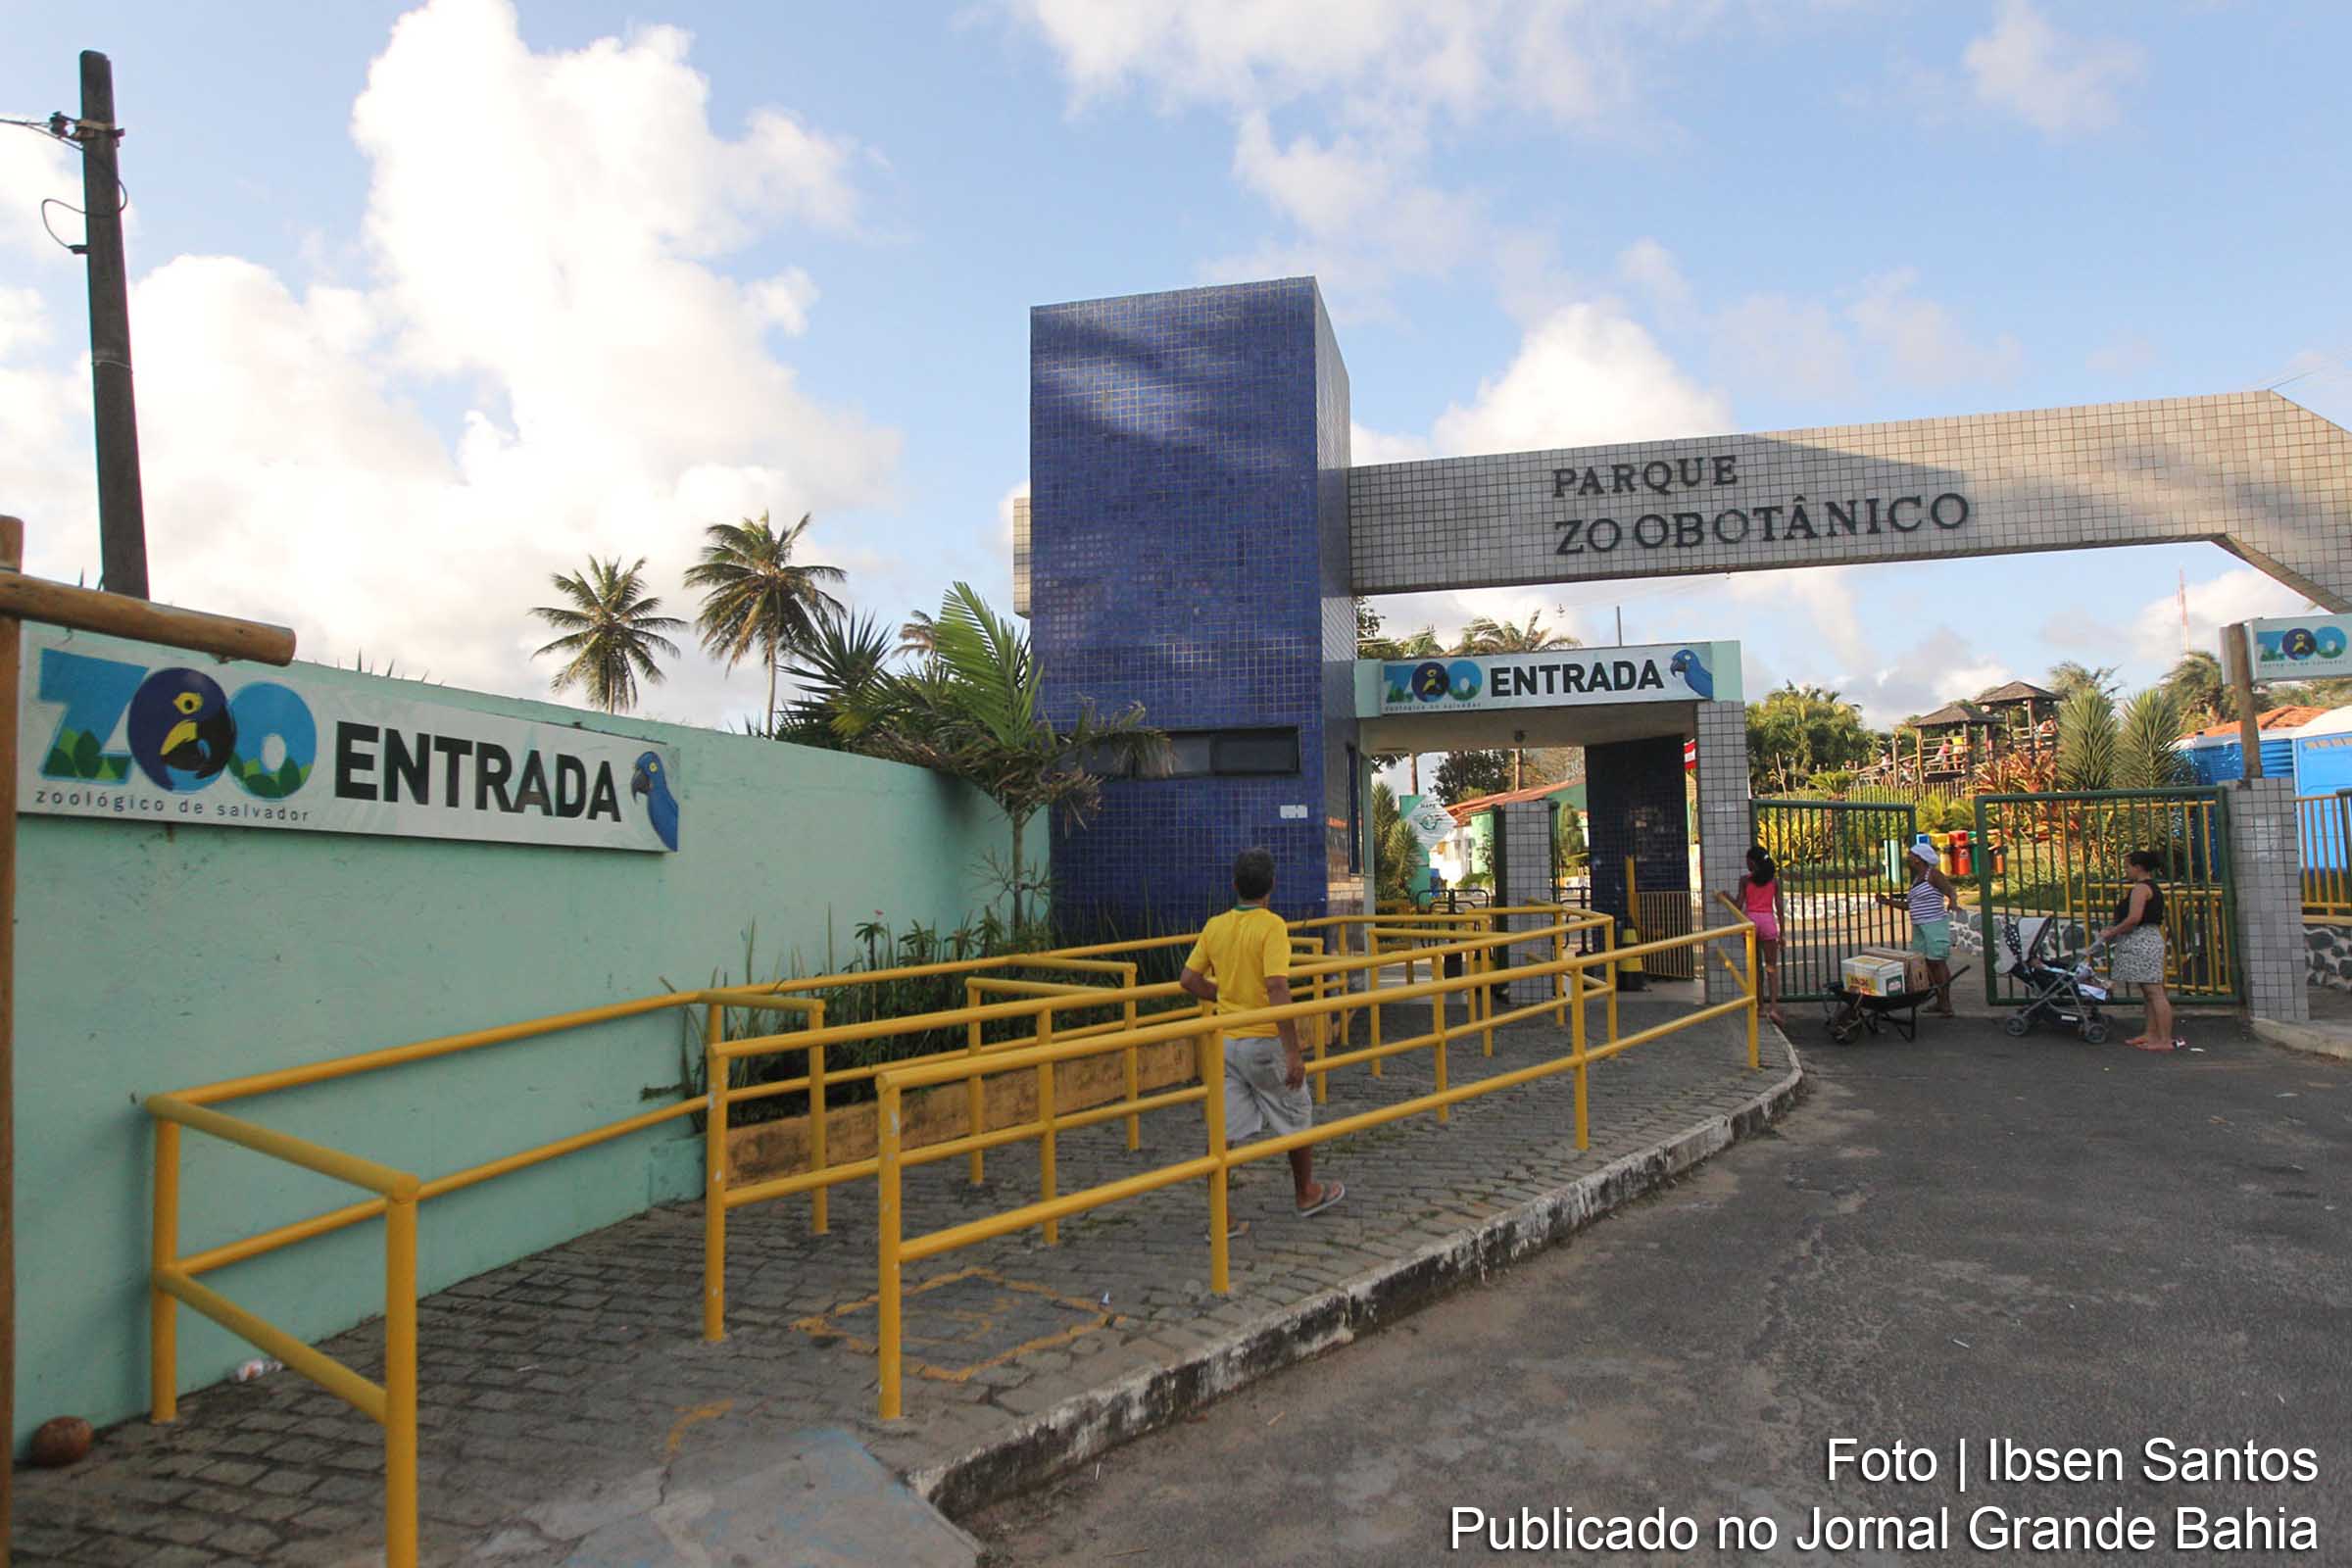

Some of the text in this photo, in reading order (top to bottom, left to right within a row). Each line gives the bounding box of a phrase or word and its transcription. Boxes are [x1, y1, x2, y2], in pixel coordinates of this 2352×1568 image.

[1553, 456, 1739, 498] PARQUE
[1555, 491, 1971, 556] ZOOBOTÂNICO
[1490, 659, 1665, 698] ENTRADA
[39, 647, 318, 800] ZOO
[335, 719, 622, 823] ENTRADA
[35, 790, 310, 822] zoológico de salvador
